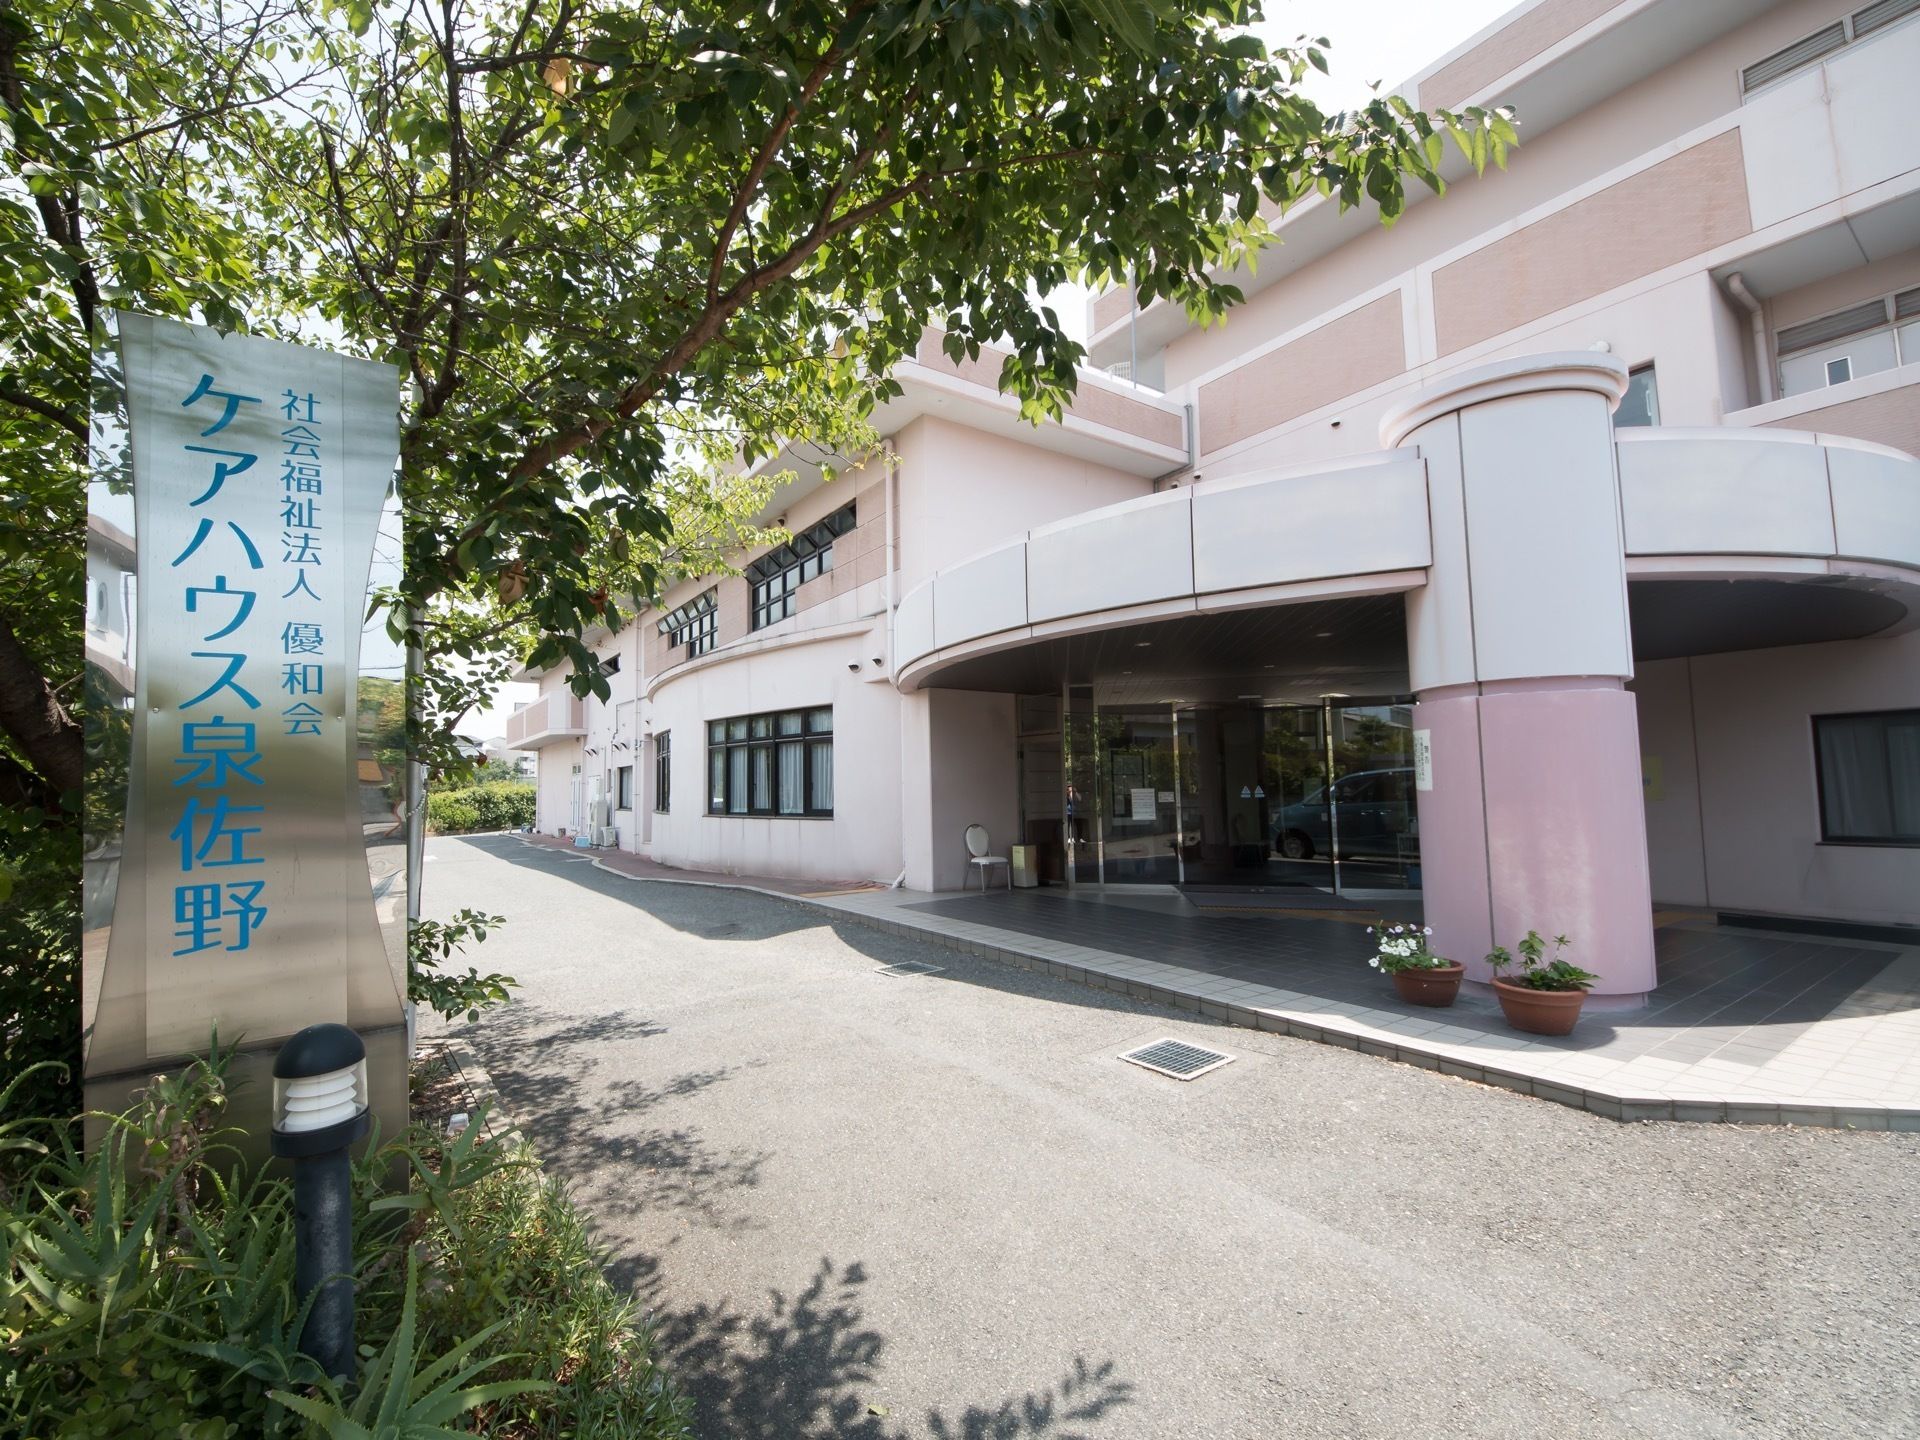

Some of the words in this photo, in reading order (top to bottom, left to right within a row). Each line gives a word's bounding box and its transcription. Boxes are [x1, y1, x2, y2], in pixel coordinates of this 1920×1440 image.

[280, 389, 322, 601] 社会福祉法人
[170, 374, 268, 957] ケアハウス泉佐野
[280, 621, 324, 736] 優和会
